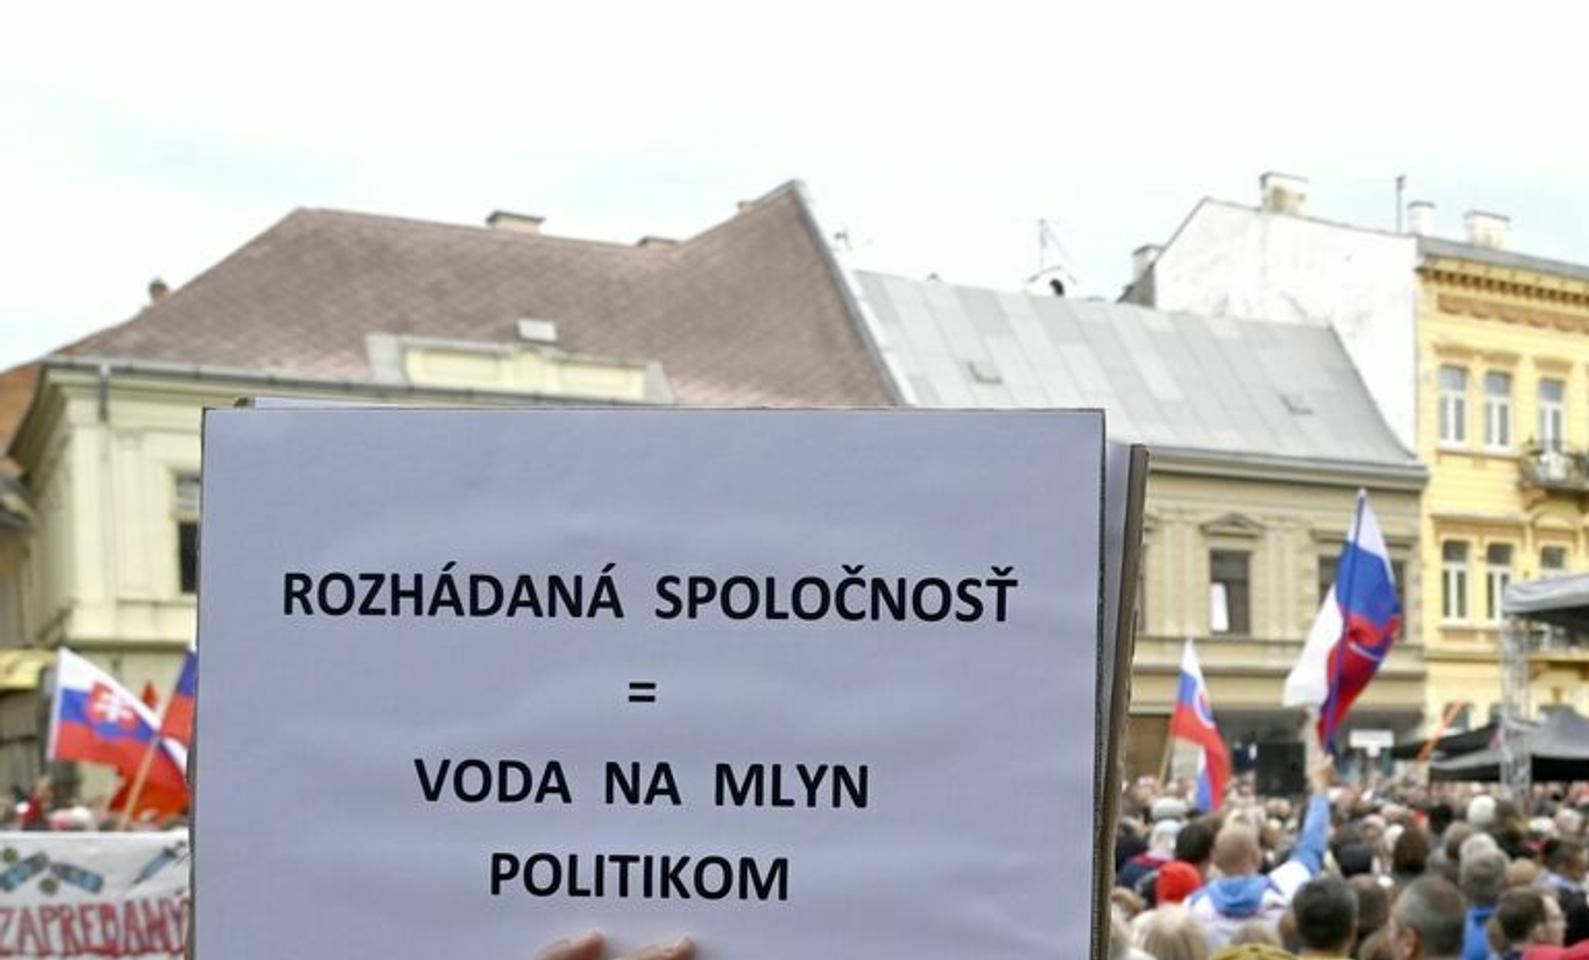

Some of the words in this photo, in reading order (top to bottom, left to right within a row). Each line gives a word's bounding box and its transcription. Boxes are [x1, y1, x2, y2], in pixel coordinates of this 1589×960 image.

[283, 560, 624, 619] ROZHÁDANÁ
[655, 564, 1019, 623] SPOLOČNOSŤ
[628, 682, 657, 703] =
[413, 758, 572, 804] VODA
[605, 761, 682, 806] NA
[715, 763, 868, 809] MLYN
[490, 852, 788, 901] POLITIKOM
